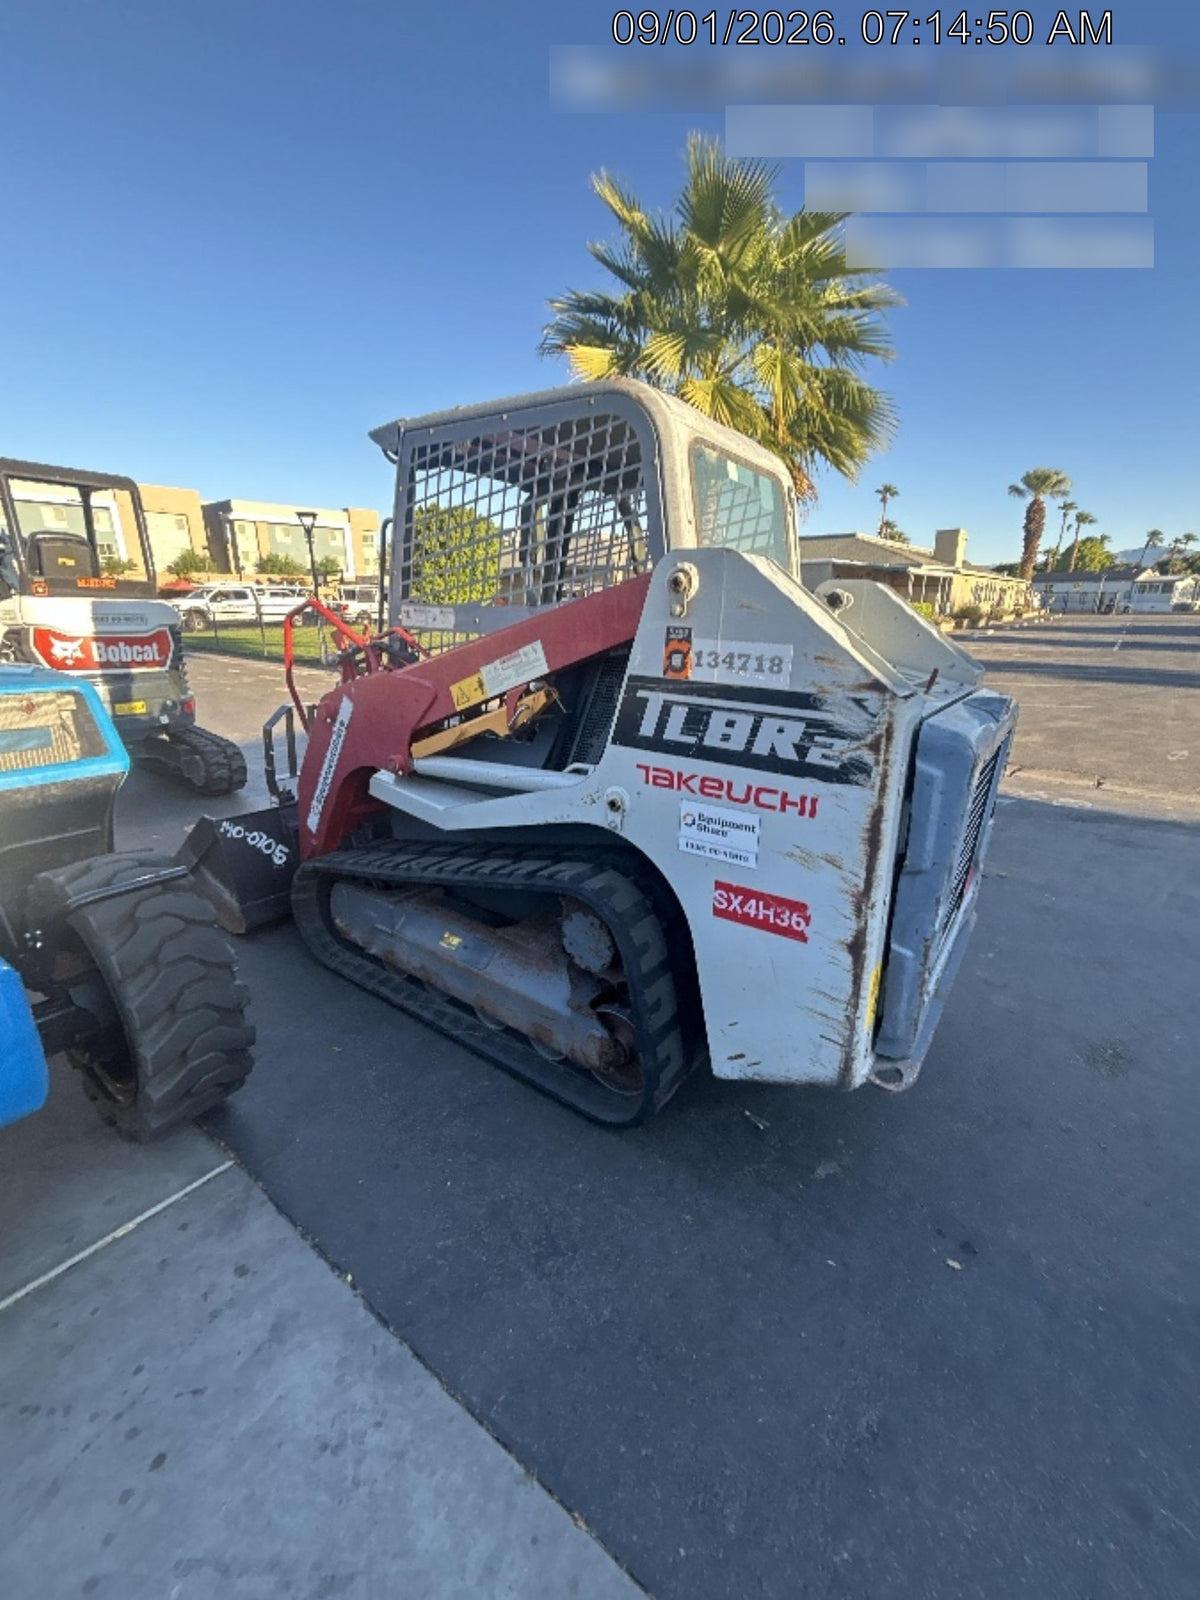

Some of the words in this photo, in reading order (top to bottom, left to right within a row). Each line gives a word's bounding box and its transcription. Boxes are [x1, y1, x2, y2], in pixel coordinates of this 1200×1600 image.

[91, 641, 159, 662] Bobcat
[694, 650, 784, 674] 134718
[698, 812, 757, 834] Equipment
[713, 889, 807, 931] SX4H36
